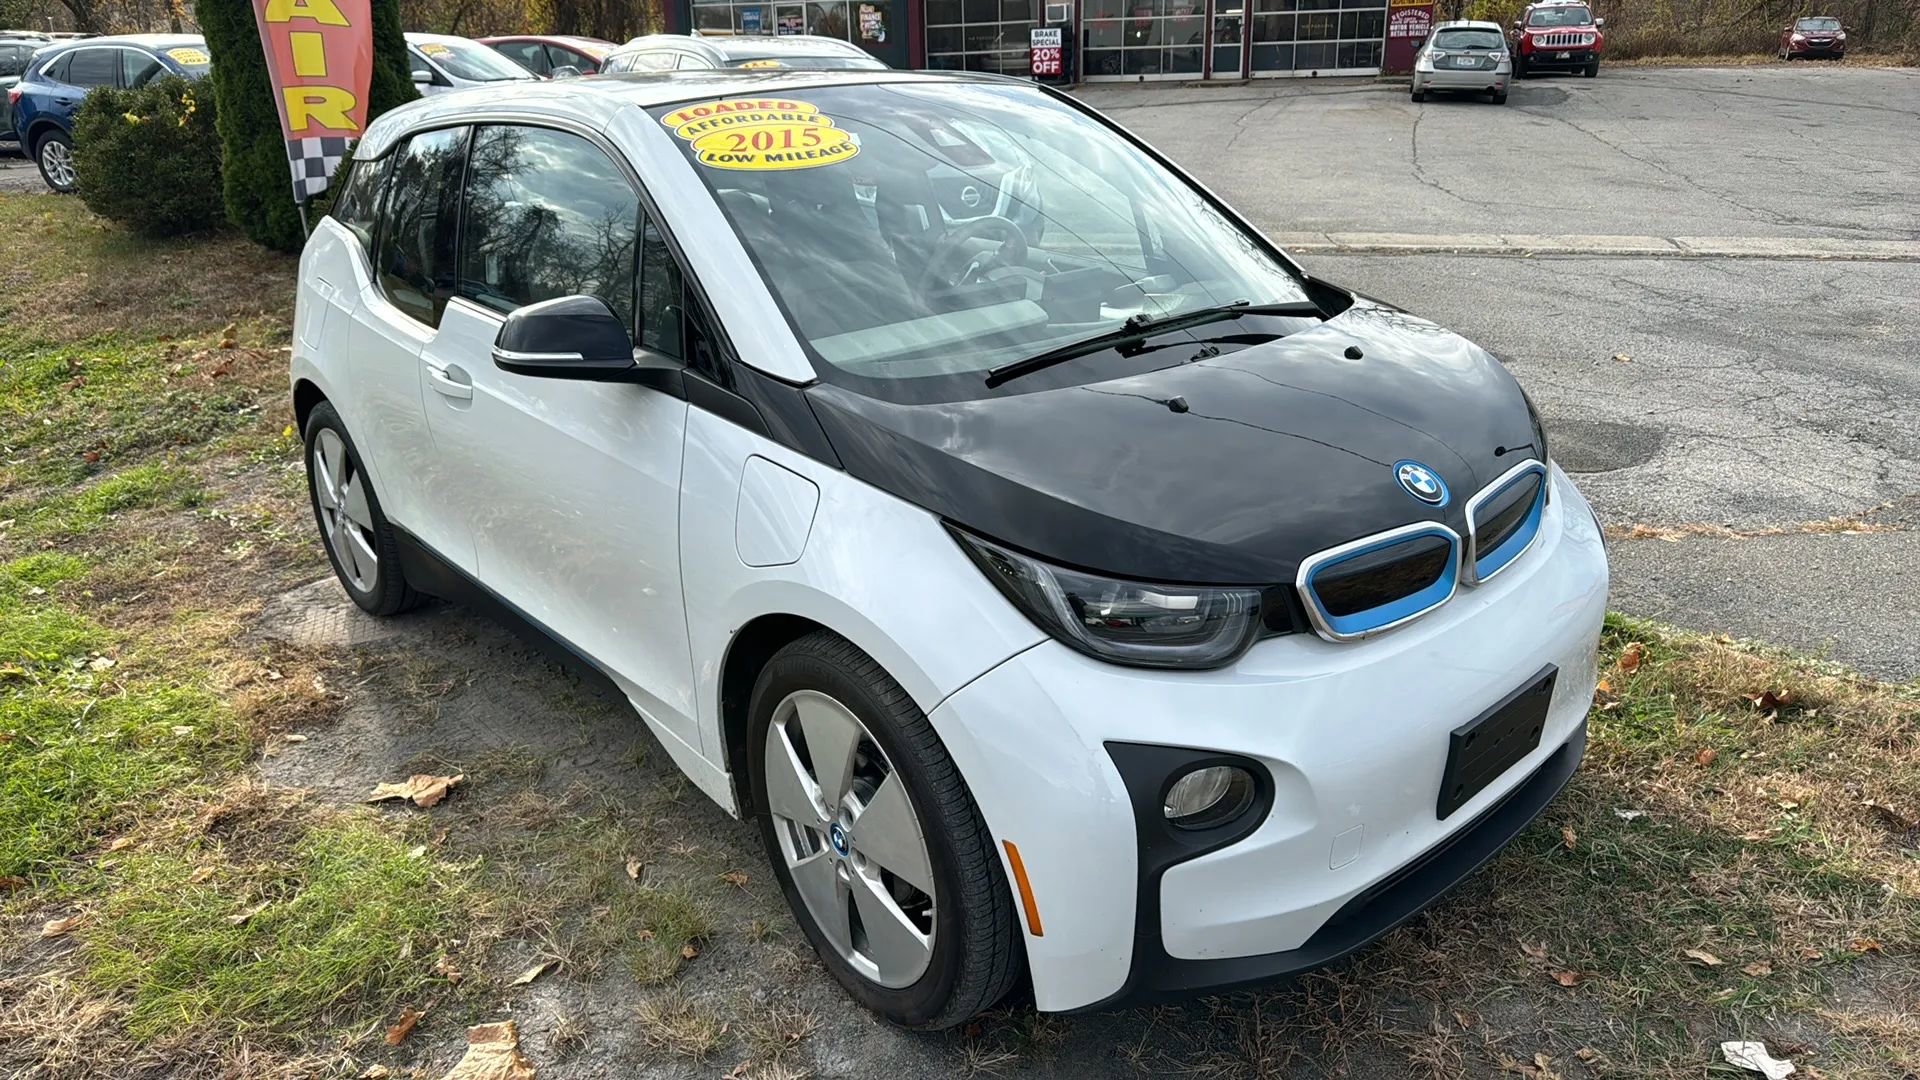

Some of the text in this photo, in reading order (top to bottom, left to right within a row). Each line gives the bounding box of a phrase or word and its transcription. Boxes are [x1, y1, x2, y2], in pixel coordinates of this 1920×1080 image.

[1391, 9, 1430, 20] REGISTERED
[1033, 49, 1060, 60] 20%
[1033, 61, 1060, 73] OFF
[677, 101, 800, 122] LOADED
[687, 113, 820, 135] AFFORDABLE
[726, 128, 821, 152] 2015
[705, 141, 853, 163] LOW MILEAGE
